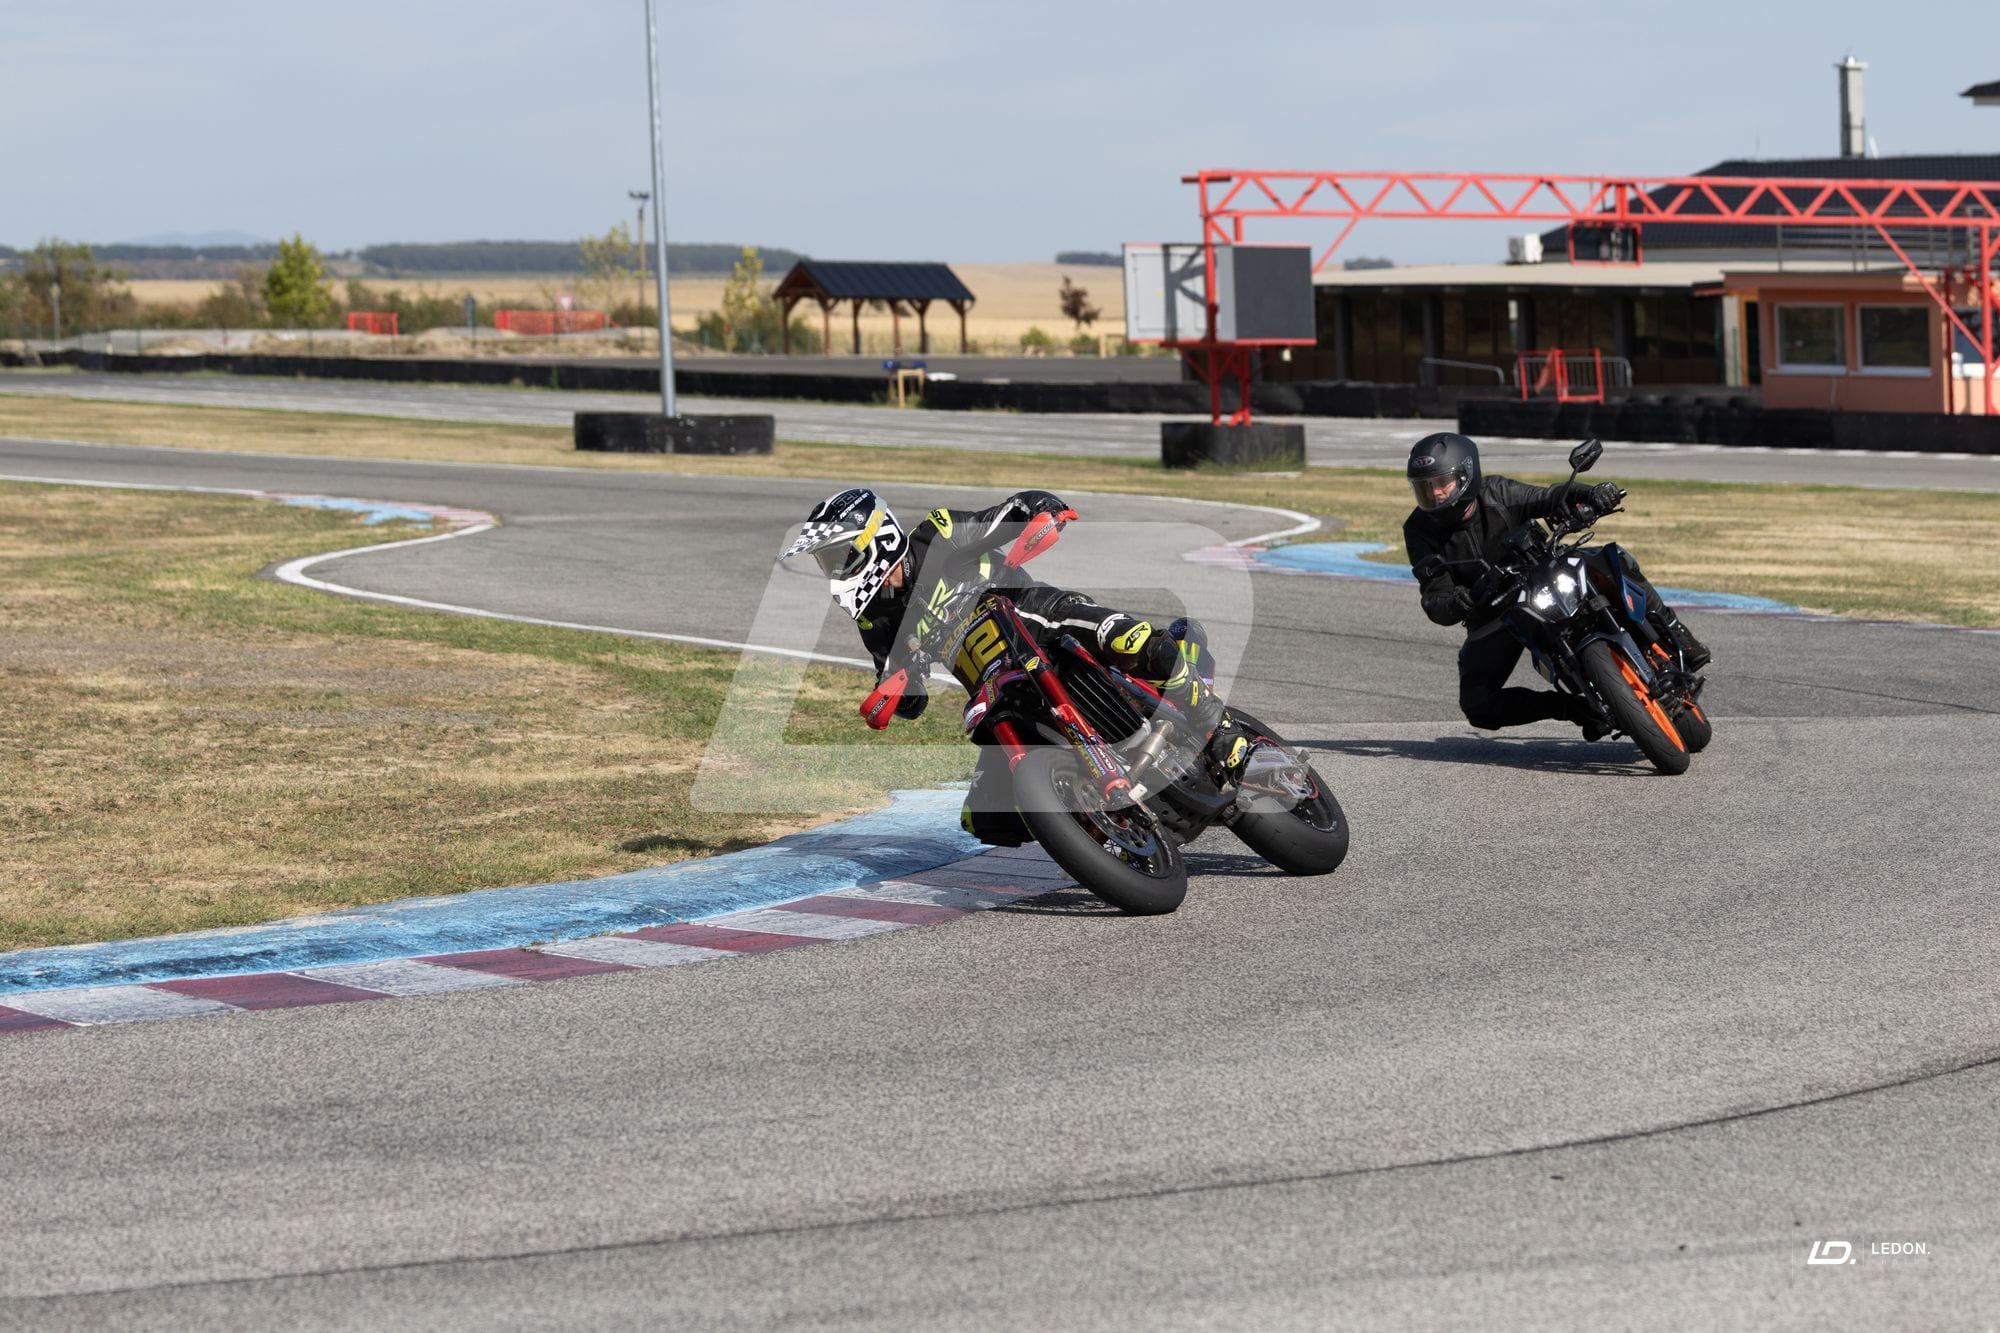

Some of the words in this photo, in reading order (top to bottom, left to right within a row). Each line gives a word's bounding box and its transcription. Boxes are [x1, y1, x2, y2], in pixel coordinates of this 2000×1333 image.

[931, 509, 949, 528] 4S
[1124, 624, 1149, 651] 4SR
[954, 618, 1008, 686] 12
